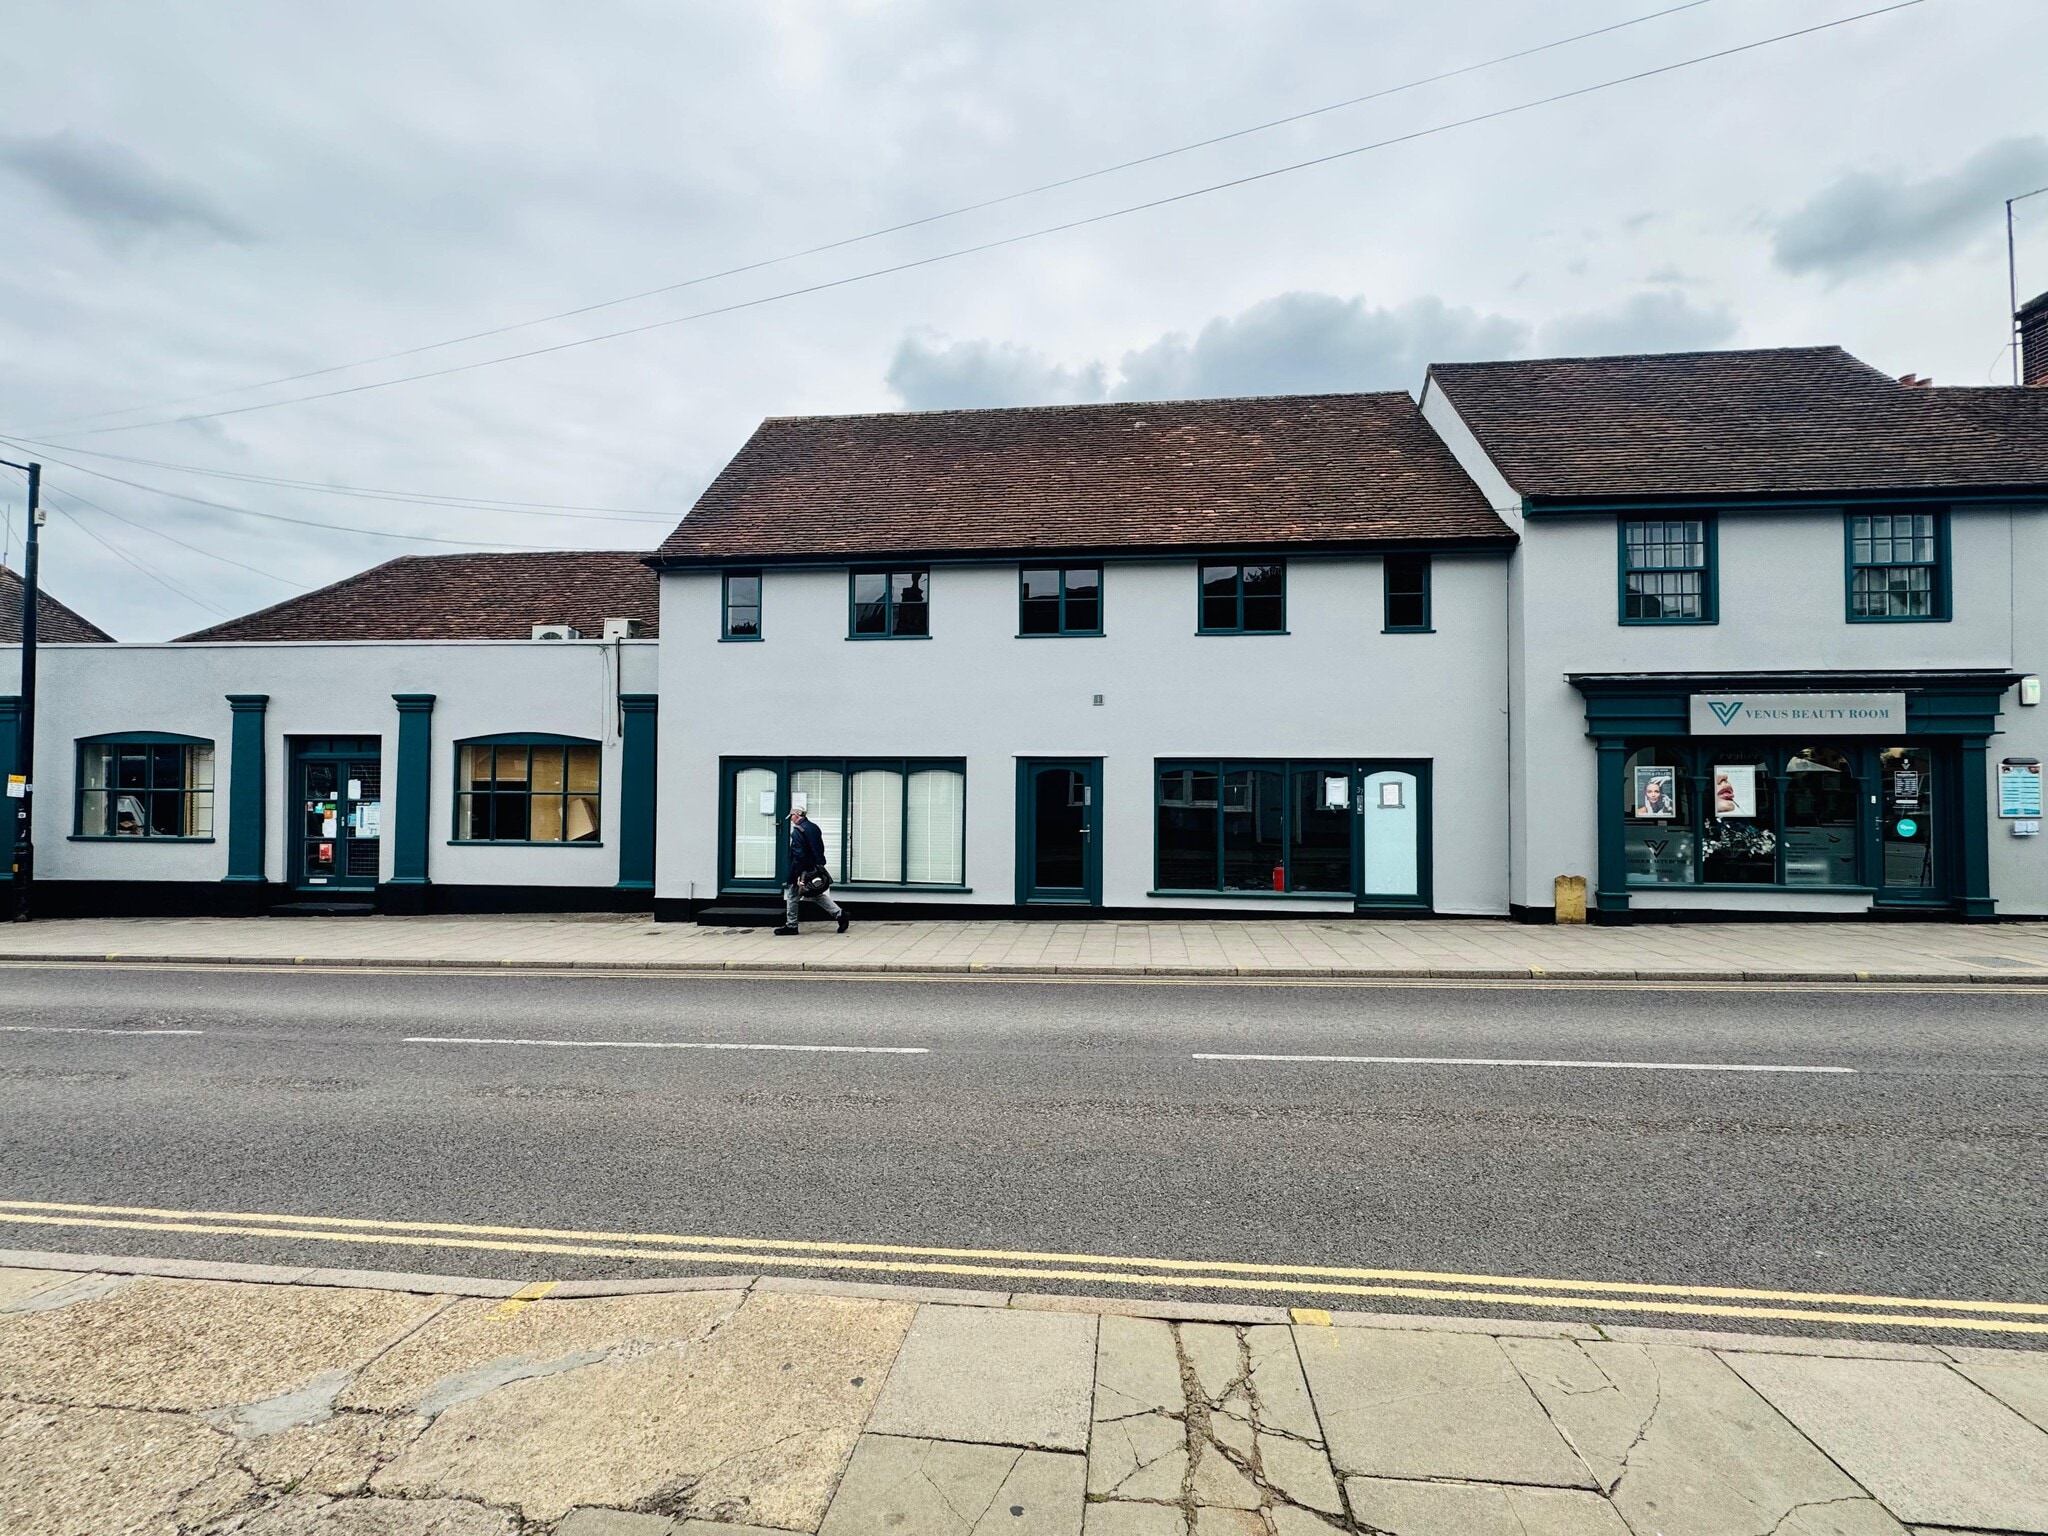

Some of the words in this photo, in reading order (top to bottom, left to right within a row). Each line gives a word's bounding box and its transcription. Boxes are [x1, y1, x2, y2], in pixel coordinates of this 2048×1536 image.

[1746, 709, 1789, 719] VENUS
[1792, 709, 1846, 719] BEAUTY
[1849, 709, 1890, 719] ROOM
